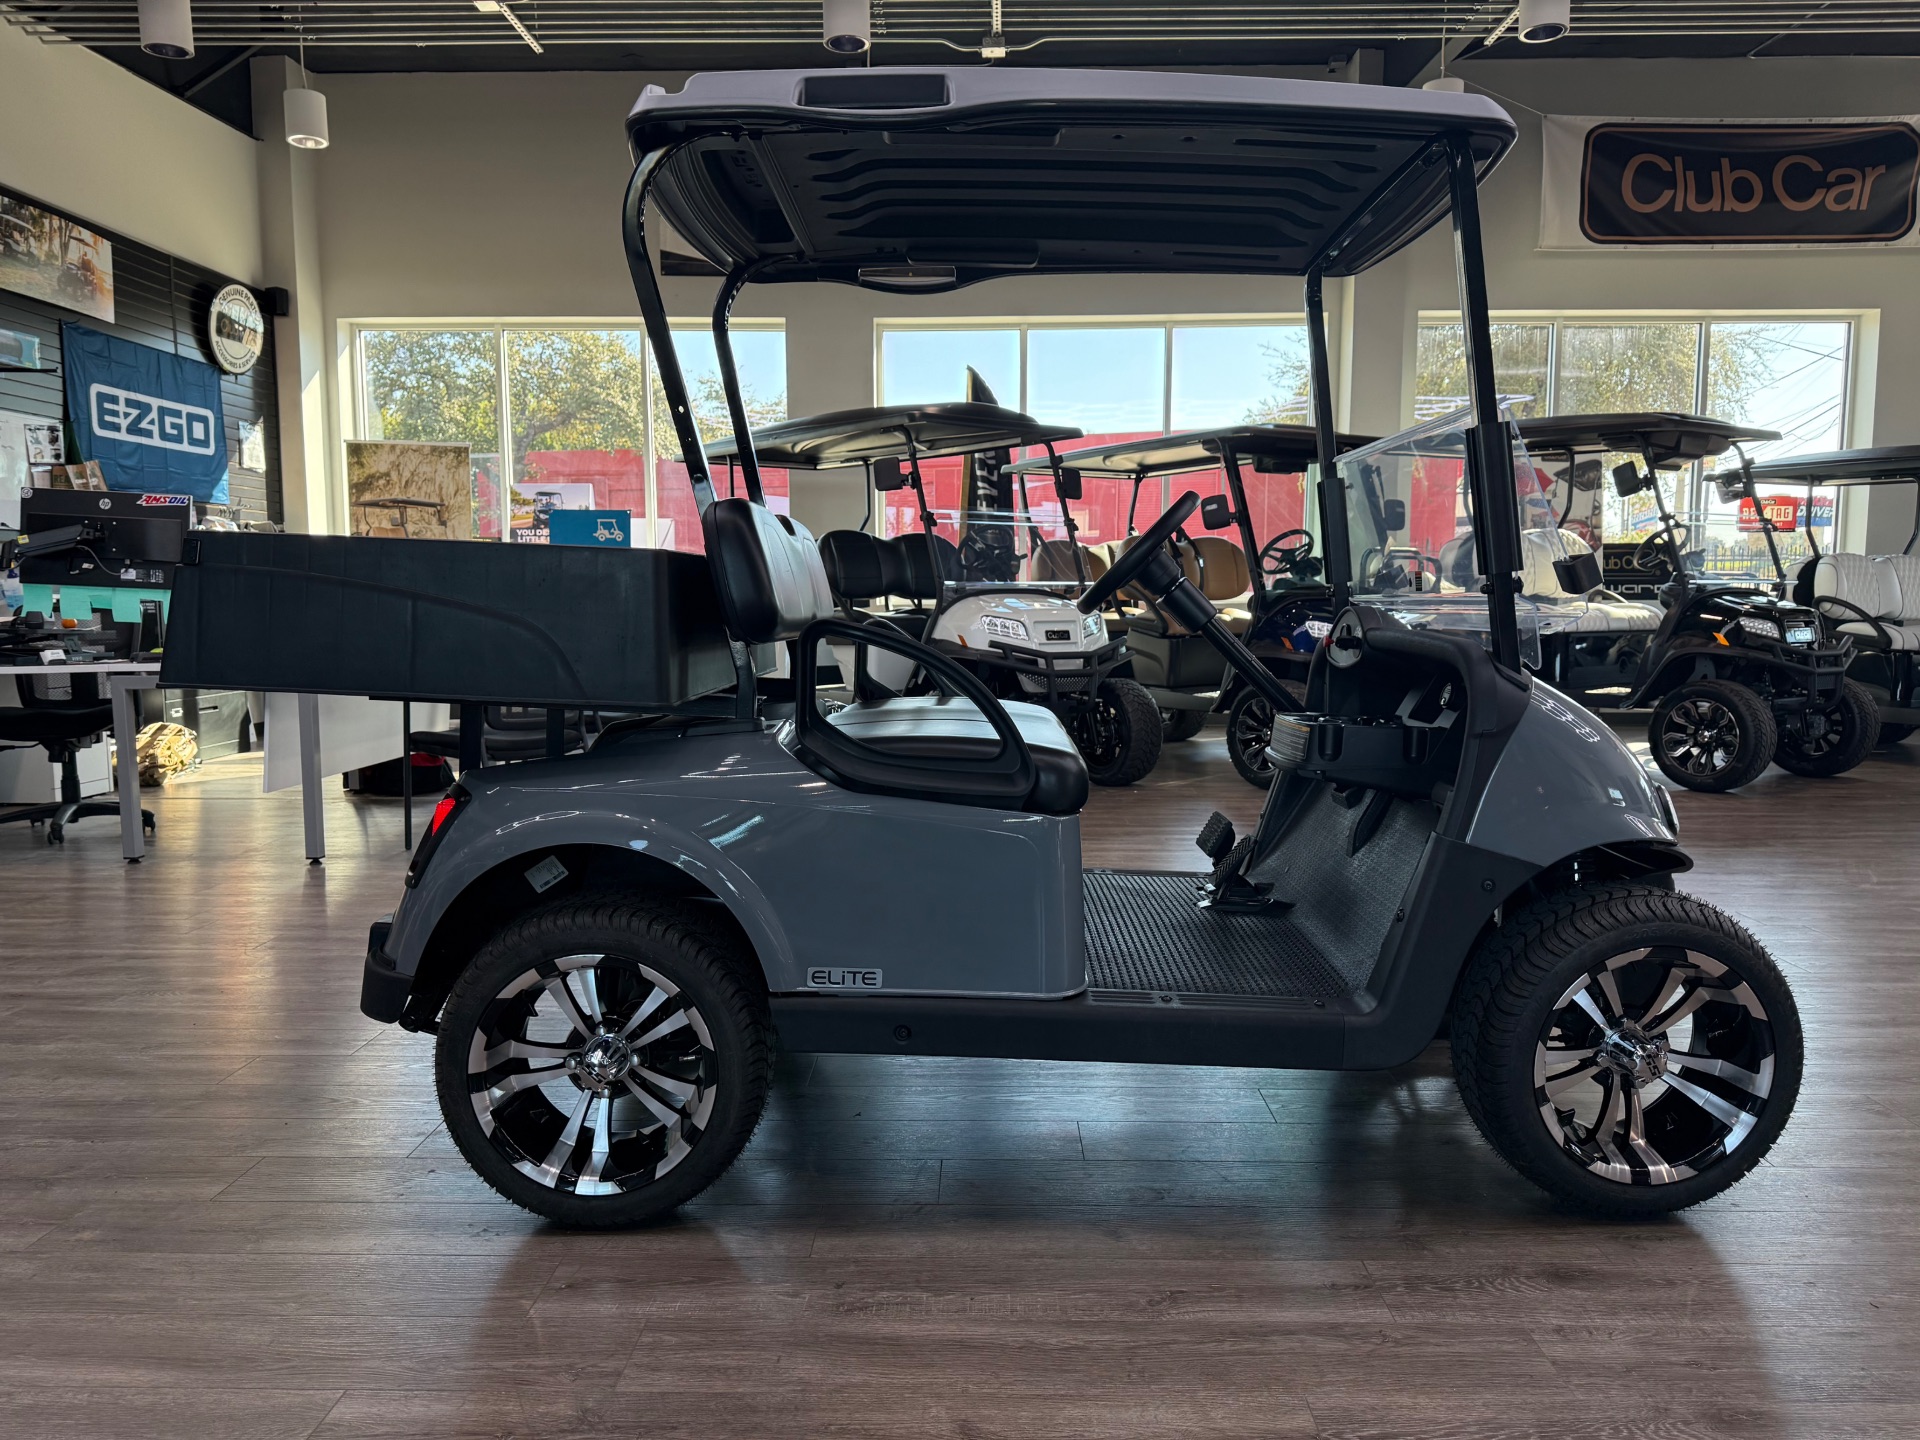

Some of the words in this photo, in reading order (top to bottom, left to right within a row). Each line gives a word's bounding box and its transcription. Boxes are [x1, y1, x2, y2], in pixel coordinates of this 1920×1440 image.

[1621, 153, 1764, 213] Club
[1772, 154, 1886, 212] Car
[218, 286, 244, 305] GENUINE
[95, 390, 211, 450] EZGO
[140, 495, 187, 505] AMSOIL
[1770, 507, 1790, 519] TAG
[516, 528, 535, 536] YOU
